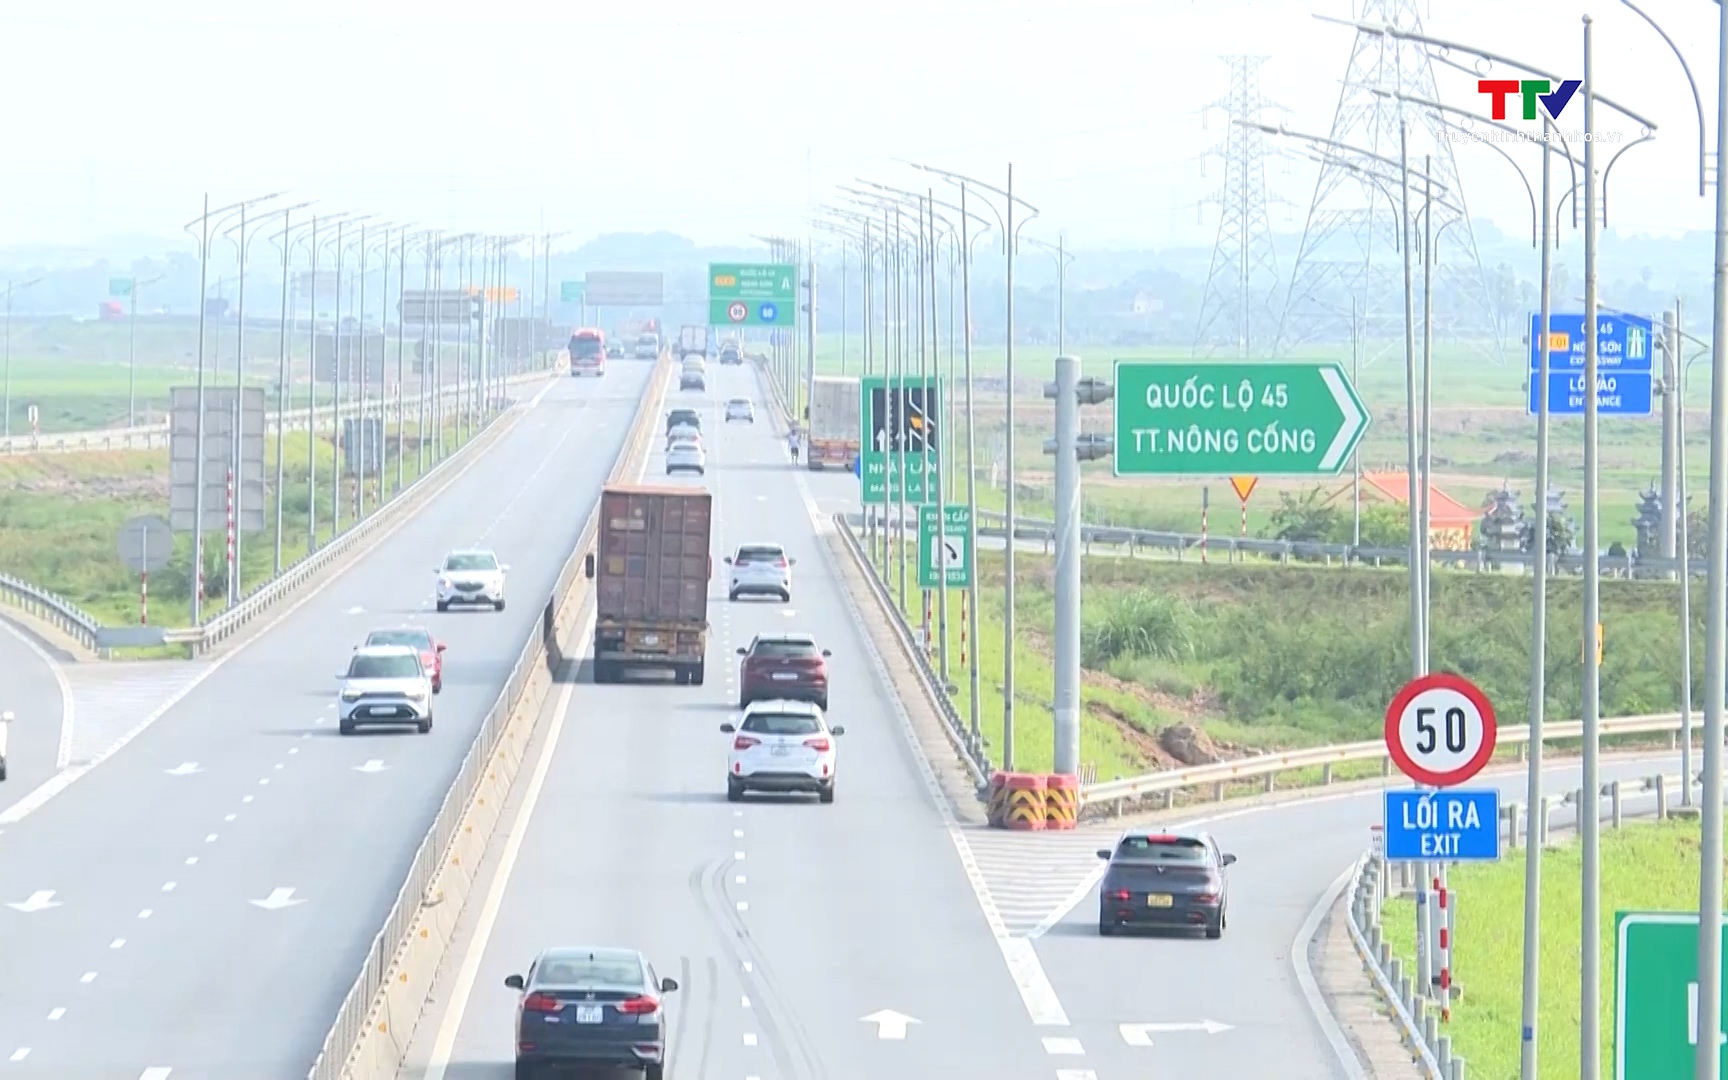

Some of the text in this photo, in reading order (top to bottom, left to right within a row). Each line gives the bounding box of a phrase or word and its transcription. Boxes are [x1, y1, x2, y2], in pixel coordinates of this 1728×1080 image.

[1146, 374, 1288, 412] QUỐC LỘ 45
[1131, 420, 1316, 454] TT.NÔNG CỐNG
[1416, 707, 1466, 754] 50
[1403, 791, 1481, 830] LỐI RA
[1421, 833, 1461, 855] EXIT
